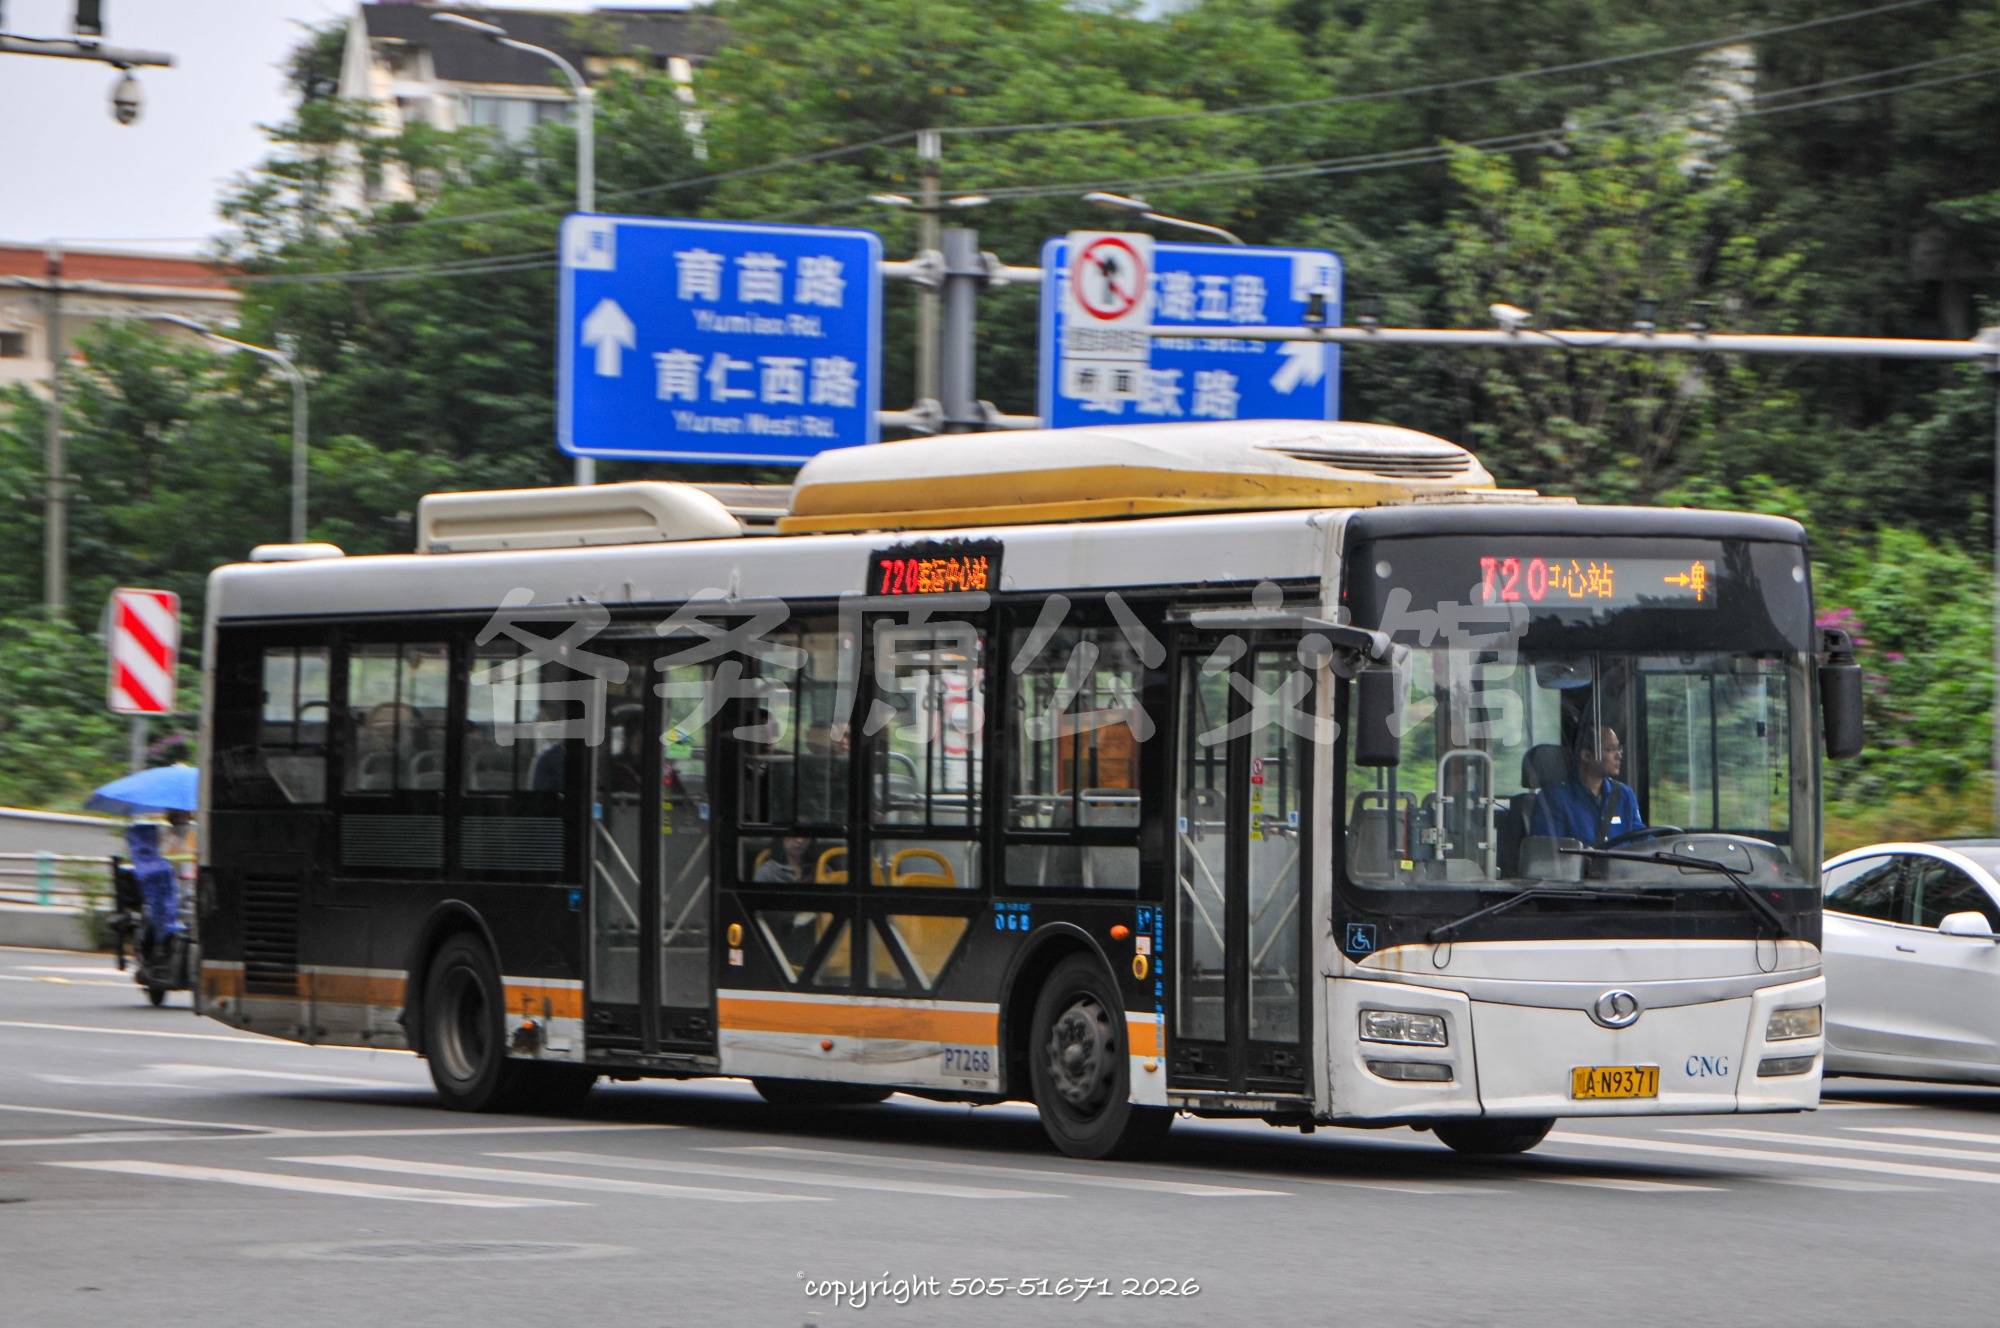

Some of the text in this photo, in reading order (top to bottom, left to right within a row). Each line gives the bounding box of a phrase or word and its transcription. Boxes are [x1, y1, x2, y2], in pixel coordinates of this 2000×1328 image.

[673, 248, 847, 308] 育苗路
[652, 349, 860, 408] 育仁西路
[880, 558, 919, 596] 720
[1480, 557, 1547, 601] 720
[944, 1048, 990, 1073] P7268
[1686, 1055, 1729, 1077] CNG
